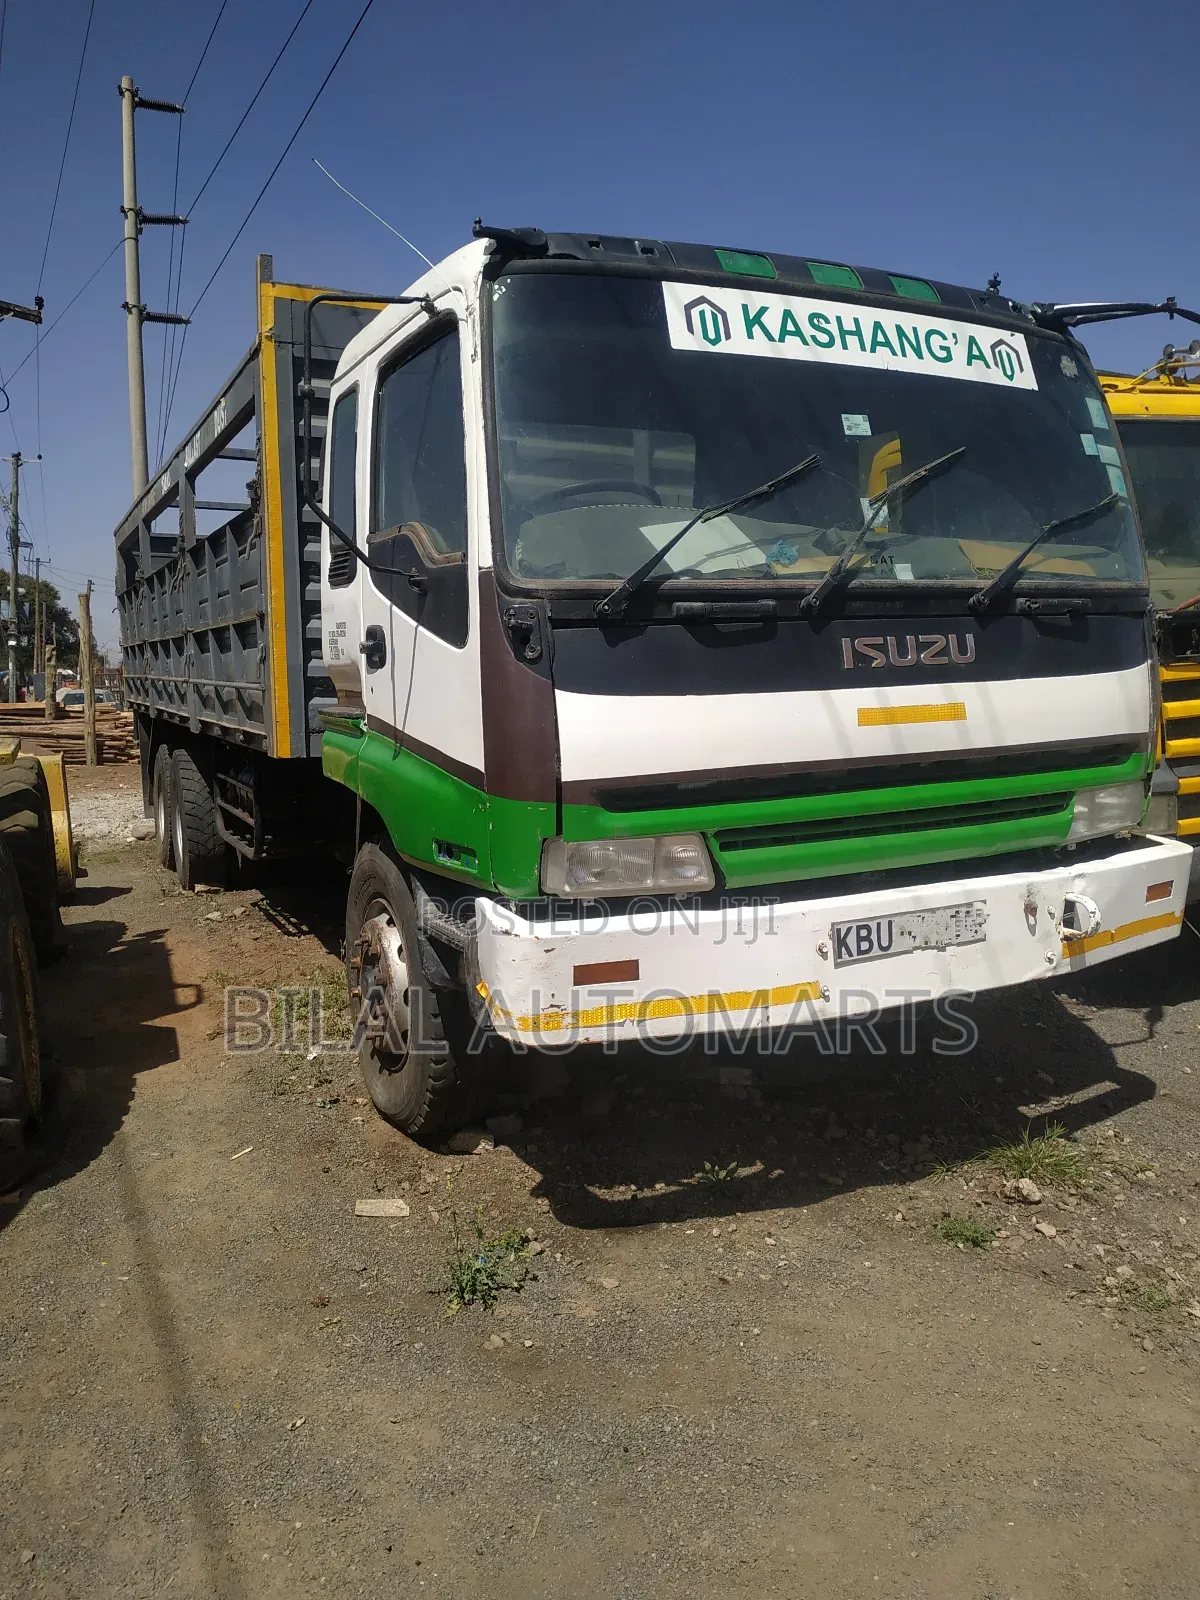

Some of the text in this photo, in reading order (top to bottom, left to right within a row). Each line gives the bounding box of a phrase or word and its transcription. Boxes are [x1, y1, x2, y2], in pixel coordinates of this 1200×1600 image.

[741, 303, 992, 369] KASHANG'A
[841, 634, 976, 669] ISUZU
[835, 919, 894, 960] KBU
